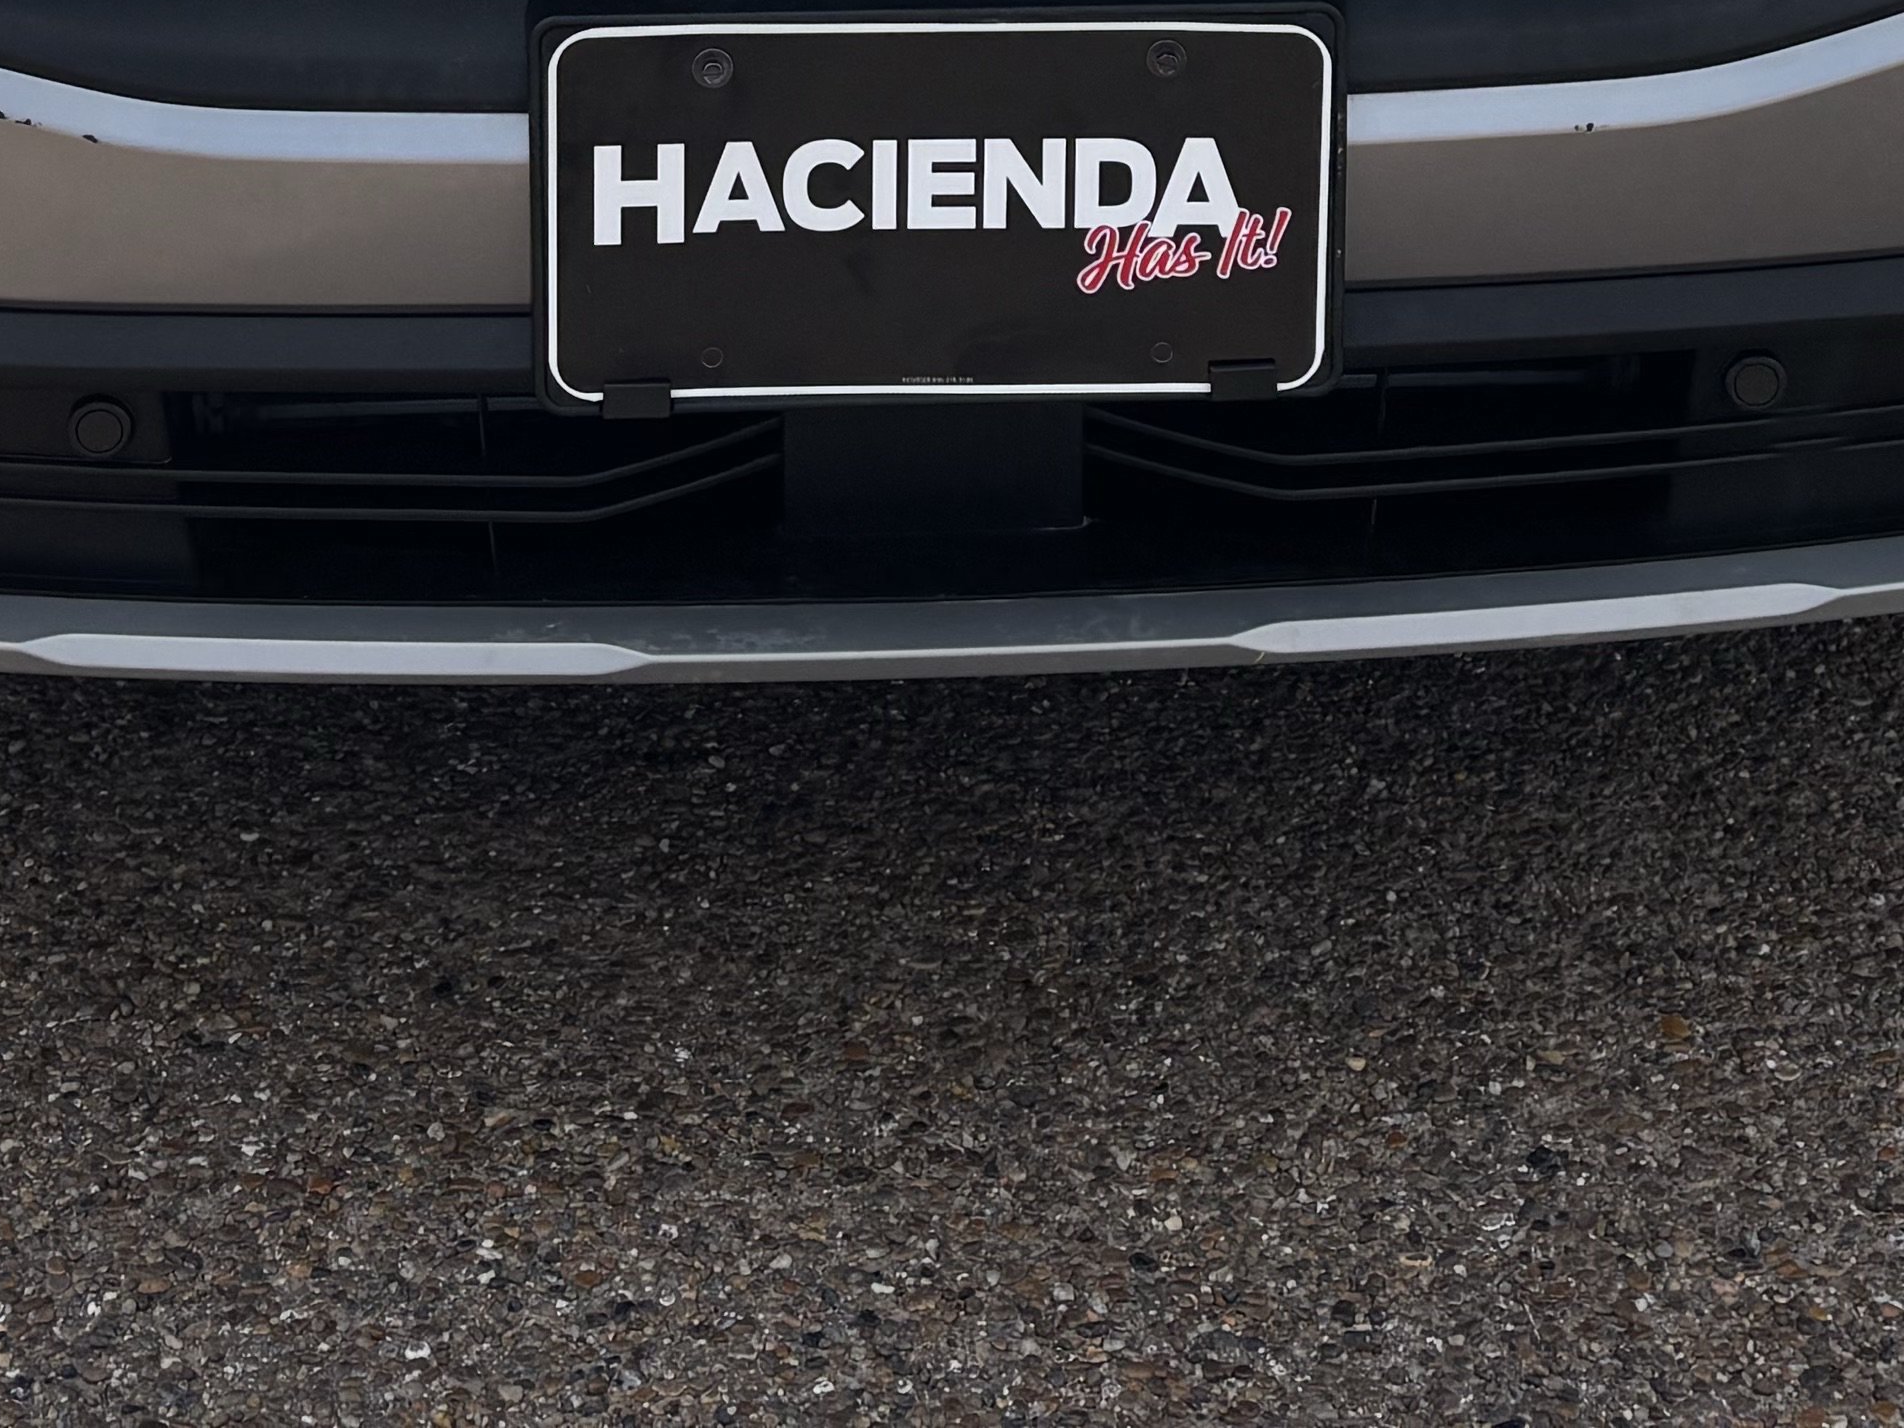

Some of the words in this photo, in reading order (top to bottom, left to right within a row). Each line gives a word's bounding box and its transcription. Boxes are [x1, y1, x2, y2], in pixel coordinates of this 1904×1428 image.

[594, 137, 1242, 246] HACIENDA
[1077, 221, 1211, 295] Has
[1217, 207, 1293, 280] It!
